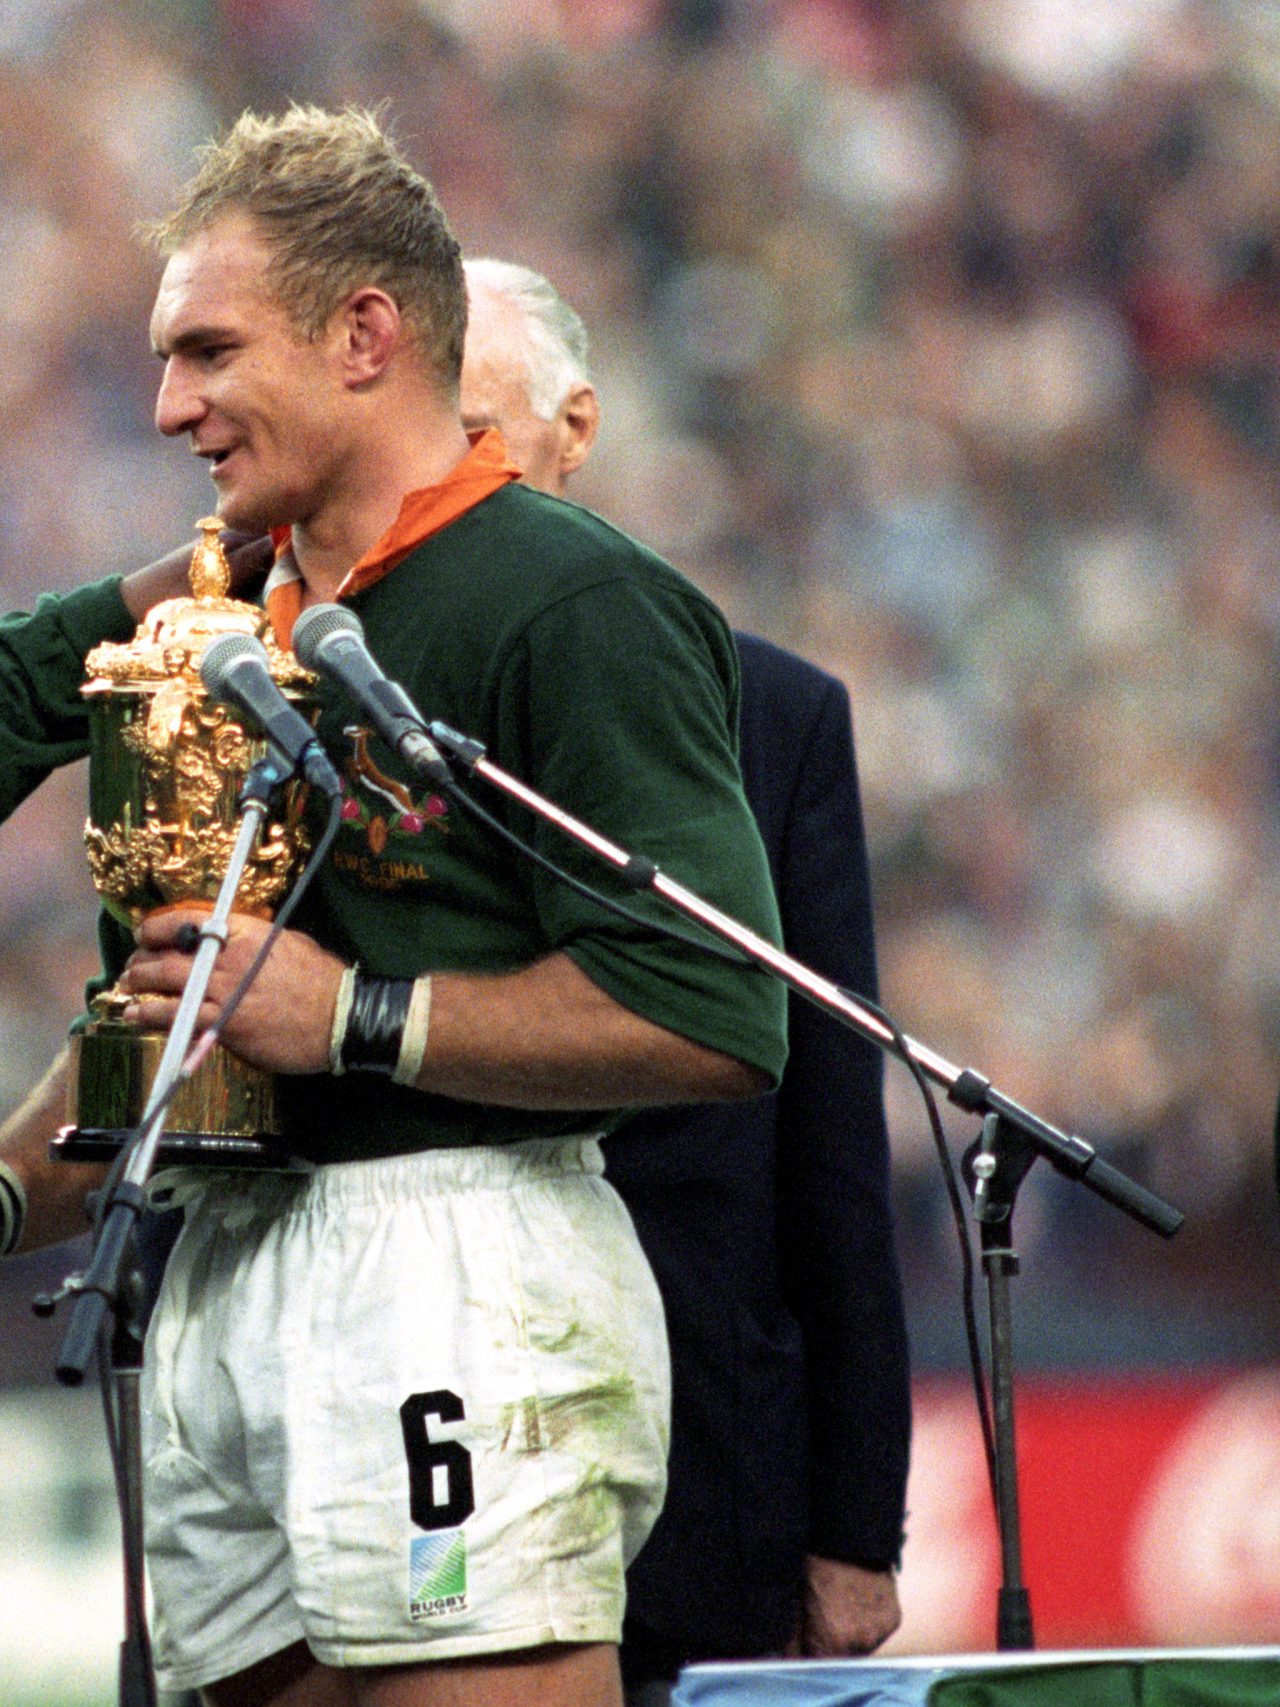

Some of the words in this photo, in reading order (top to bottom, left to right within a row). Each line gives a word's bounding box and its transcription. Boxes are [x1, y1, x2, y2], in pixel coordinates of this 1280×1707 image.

[380, 862, 430, 880] FINAL
[399, 1389, 475, 1531] 6
[410, 1594, 466, 1614] RUGBY
